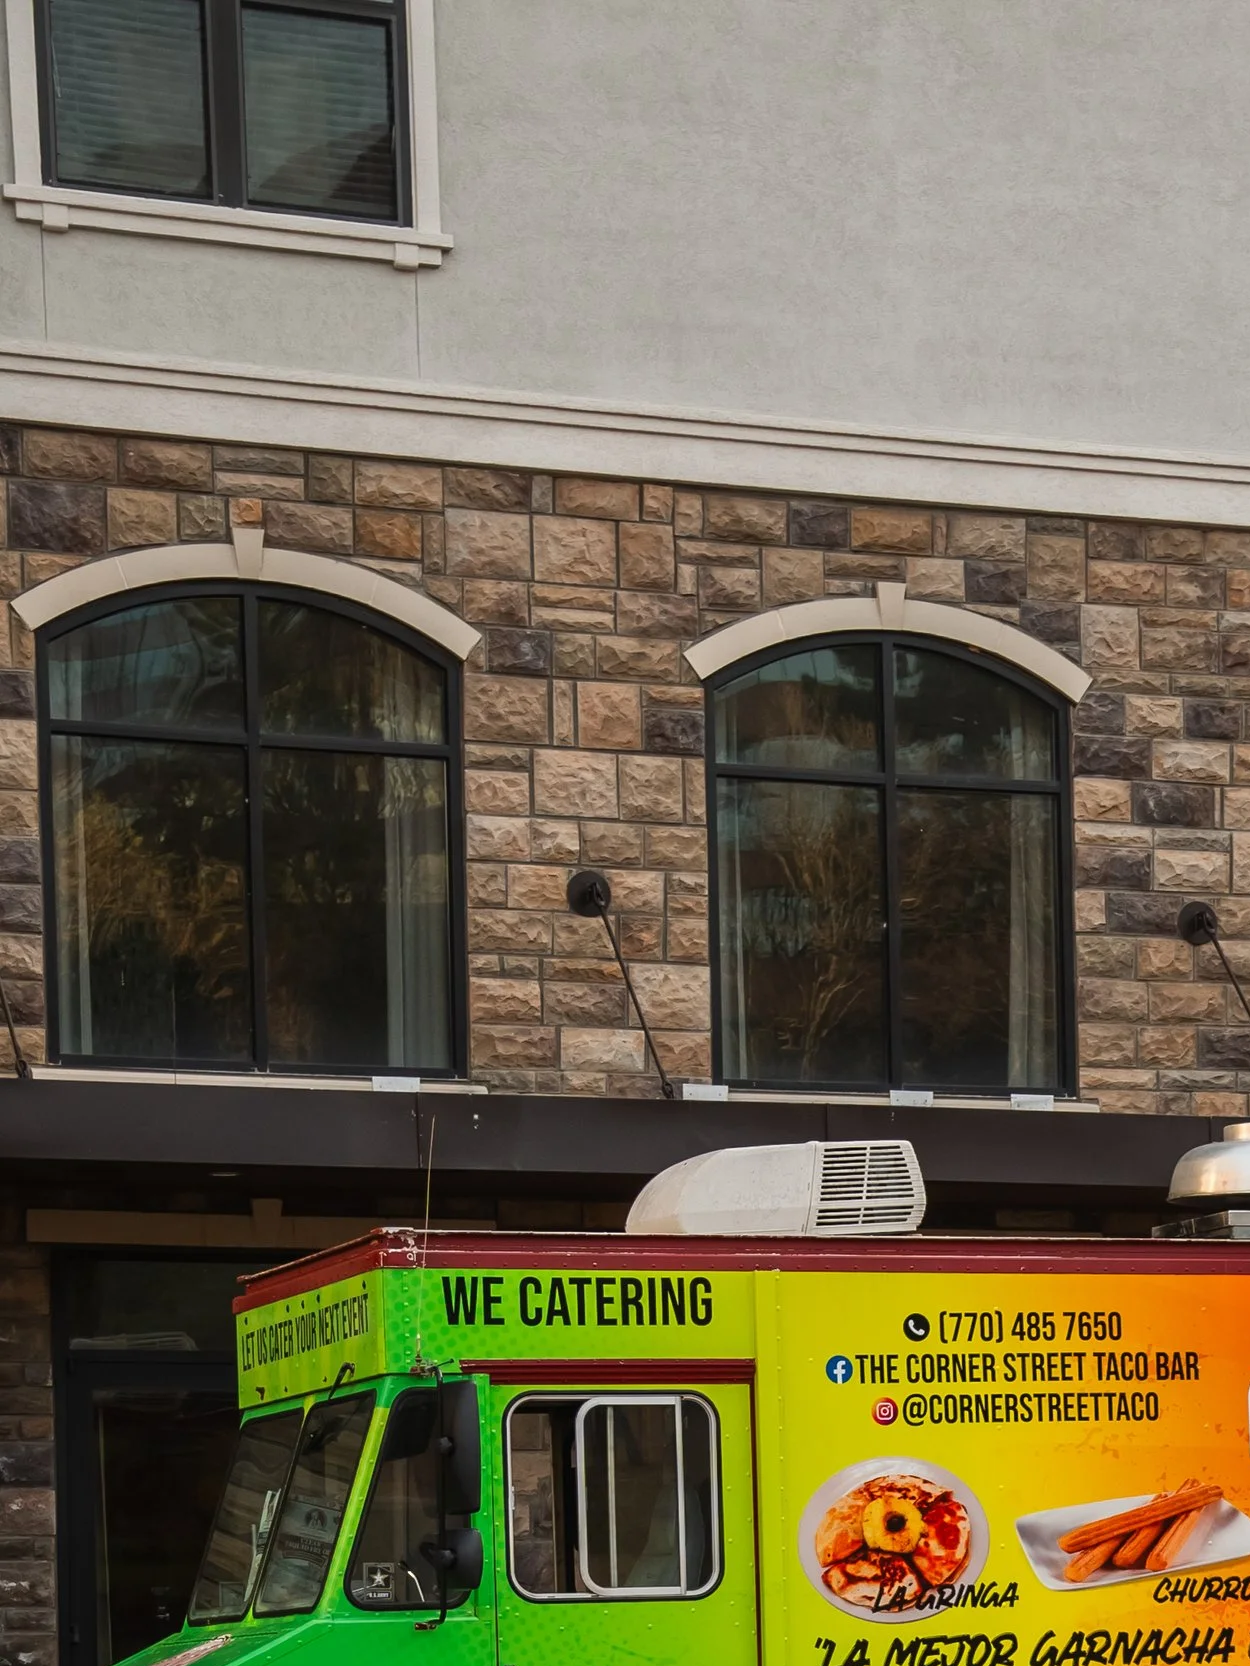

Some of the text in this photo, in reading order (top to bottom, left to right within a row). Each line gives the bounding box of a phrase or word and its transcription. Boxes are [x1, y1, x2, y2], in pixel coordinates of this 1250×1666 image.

[441, 1276, 713, 1326] WE CATERING
[242, 1293, 369, 1372] LET US CATER YOUR NEXT EVENT
[940, 1310, 1123, 1343] (770) 485 7650
[855, 1350, 1200, 1384] THE CORNER STREET TACO BAR
[902, 1391, 1160, 1427] @CORNERSTREETTACO
[871, 1580, 1020, 1614] LA GRINGA
